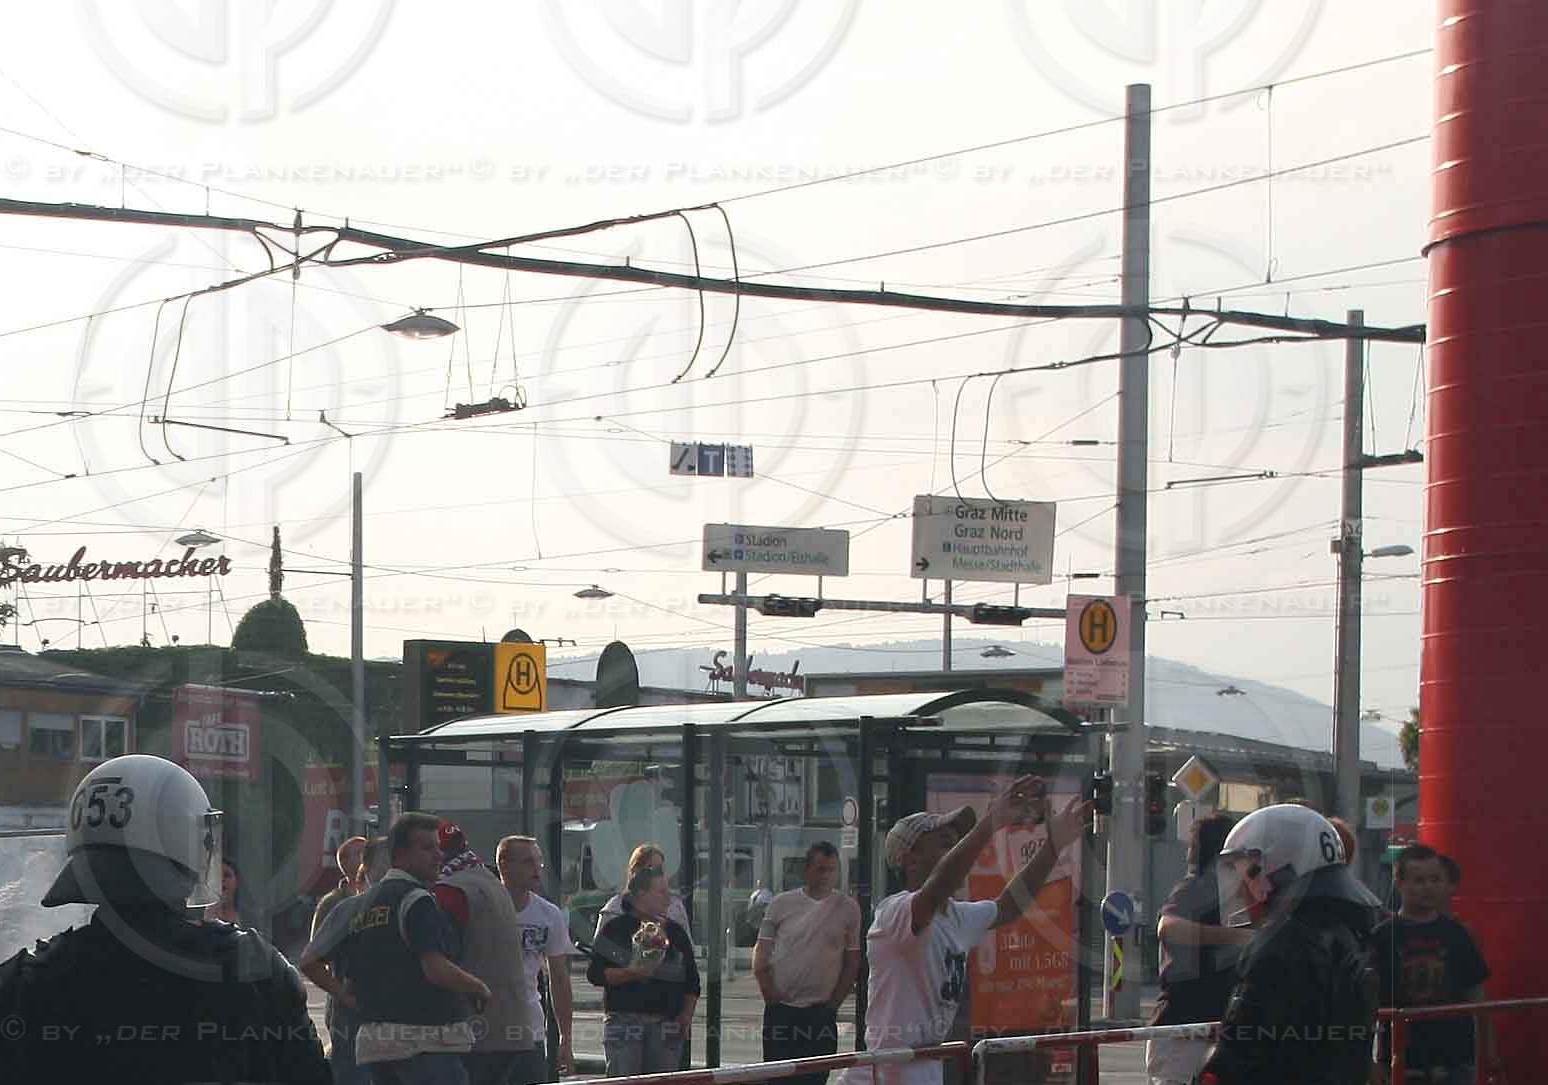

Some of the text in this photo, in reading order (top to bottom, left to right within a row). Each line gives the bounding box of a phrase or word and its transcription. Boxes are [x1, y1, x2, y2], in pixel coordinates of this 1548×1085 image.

[955, 504, 1029, 522] Graz Mitte
[954, 523, 1024, 541] Graz Nord
[515, 660, 531, 687] H
[187, 730, 246, 756] ROTH
